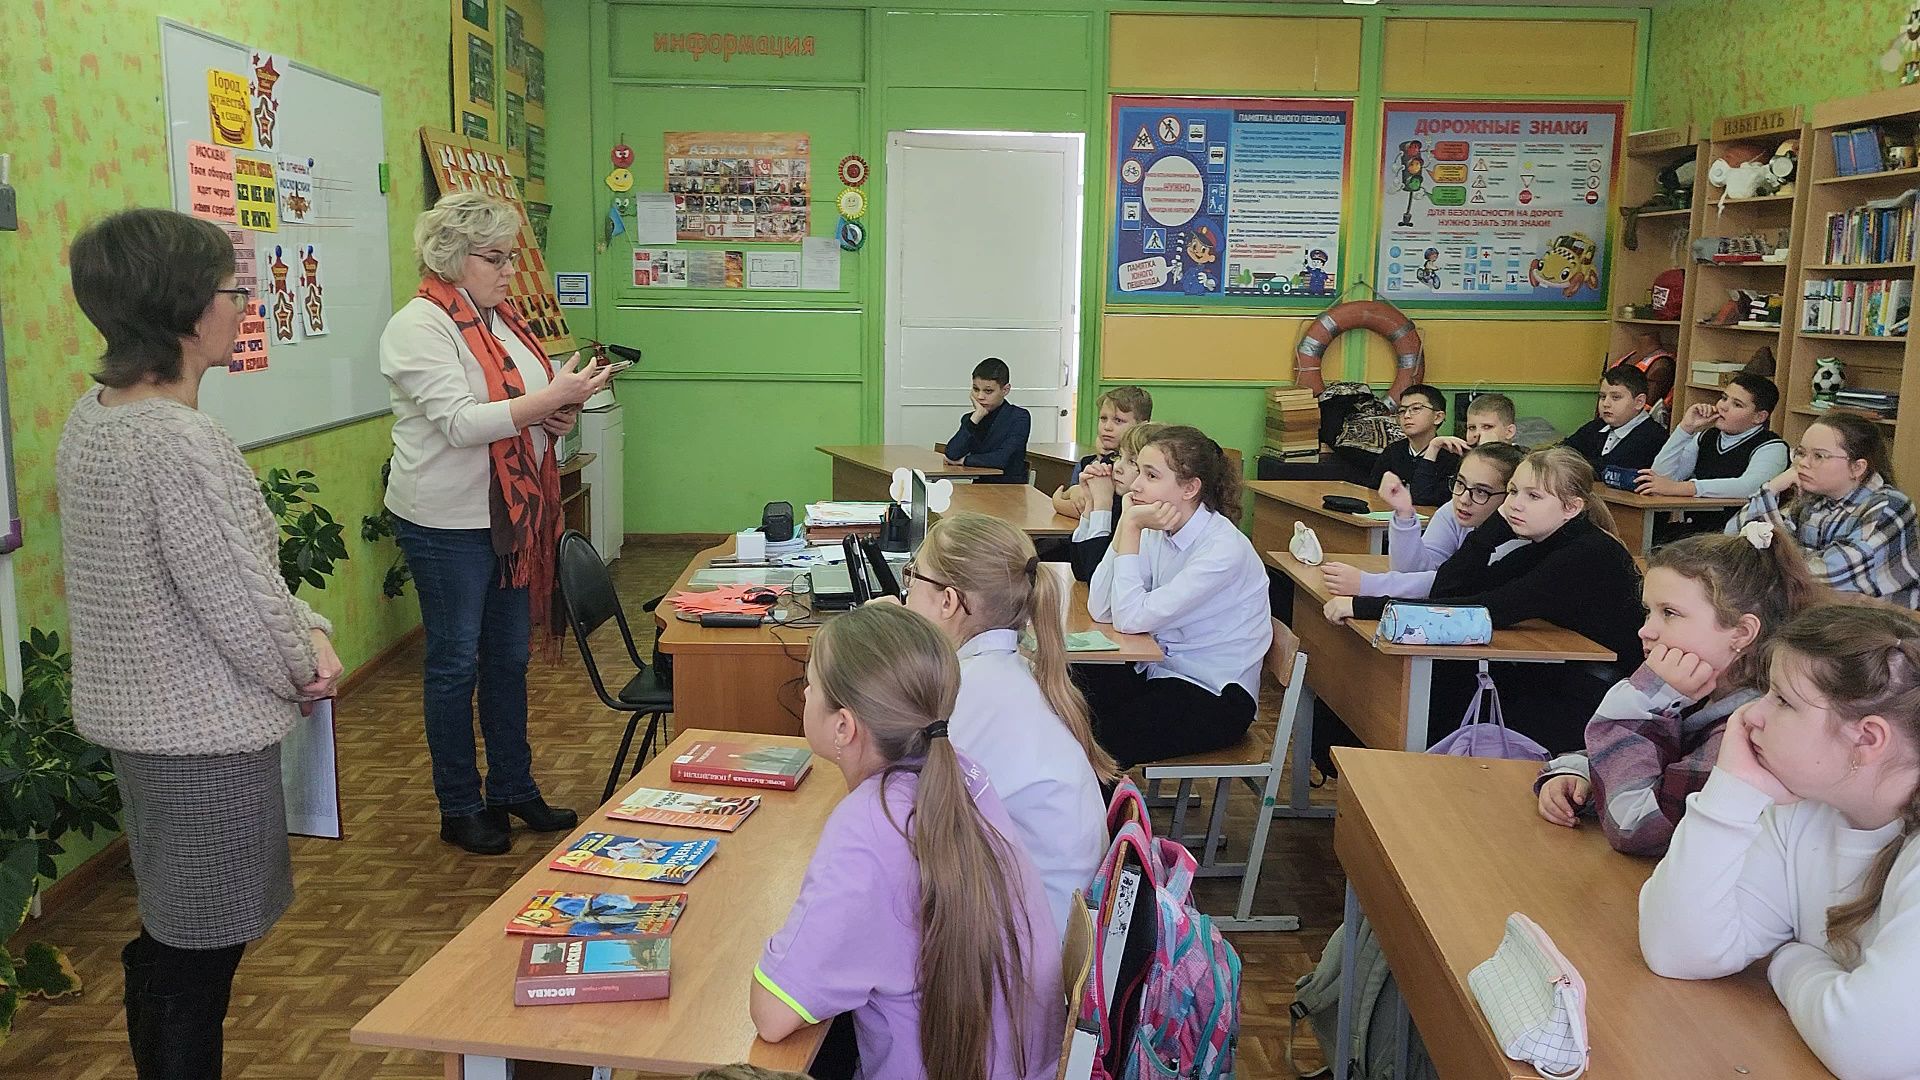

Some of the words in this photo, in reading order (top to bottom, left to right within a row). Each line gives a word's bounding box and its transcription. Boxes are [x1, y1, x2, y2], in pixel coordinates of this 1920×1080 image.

[654, 32, 815, 62] информация
[213, 70, 240, 95] Город
[1239, 113, 1273, 123] ПАМЯТКА
[1273, 114, 1300, 123] ЮНОГО
[1300, 115, 1341, 124] ПЕШЕХОДА
[1723, 112, 1785, 136] ИЗБЕГАТЬ
[1415, 118, 1521, 136] ДОРОЖНЫЕ
[1529, 120, 1588, 135] ЗНАКИ
[1427, 209, 1446, 218] ДЛЯ
[1448, 208, 1515, 218] БЕЗОПАСНОСТИ
[1516, 209, 1529, 218] НА
[1530, 209, 1564, 218] ДОРОГЕ
[1438, 218, 1471, 227] НУЖНО
[1473, 219, 1500, 227] ЗНАТЬ
[1501, 219, 1520, 227] ЭТИ
[706, 224, 725, 236] 01
[1127, 260, 1156, 272] ПАМЯТКА
[1131, 269, 1154, 280] ЮНОГО
[1127, 276, 1161, 290] ПЕШЕХОДА
[565, 940, 584, 974] МОСКВА
[527, 987, 577, 999] МОСКВА
